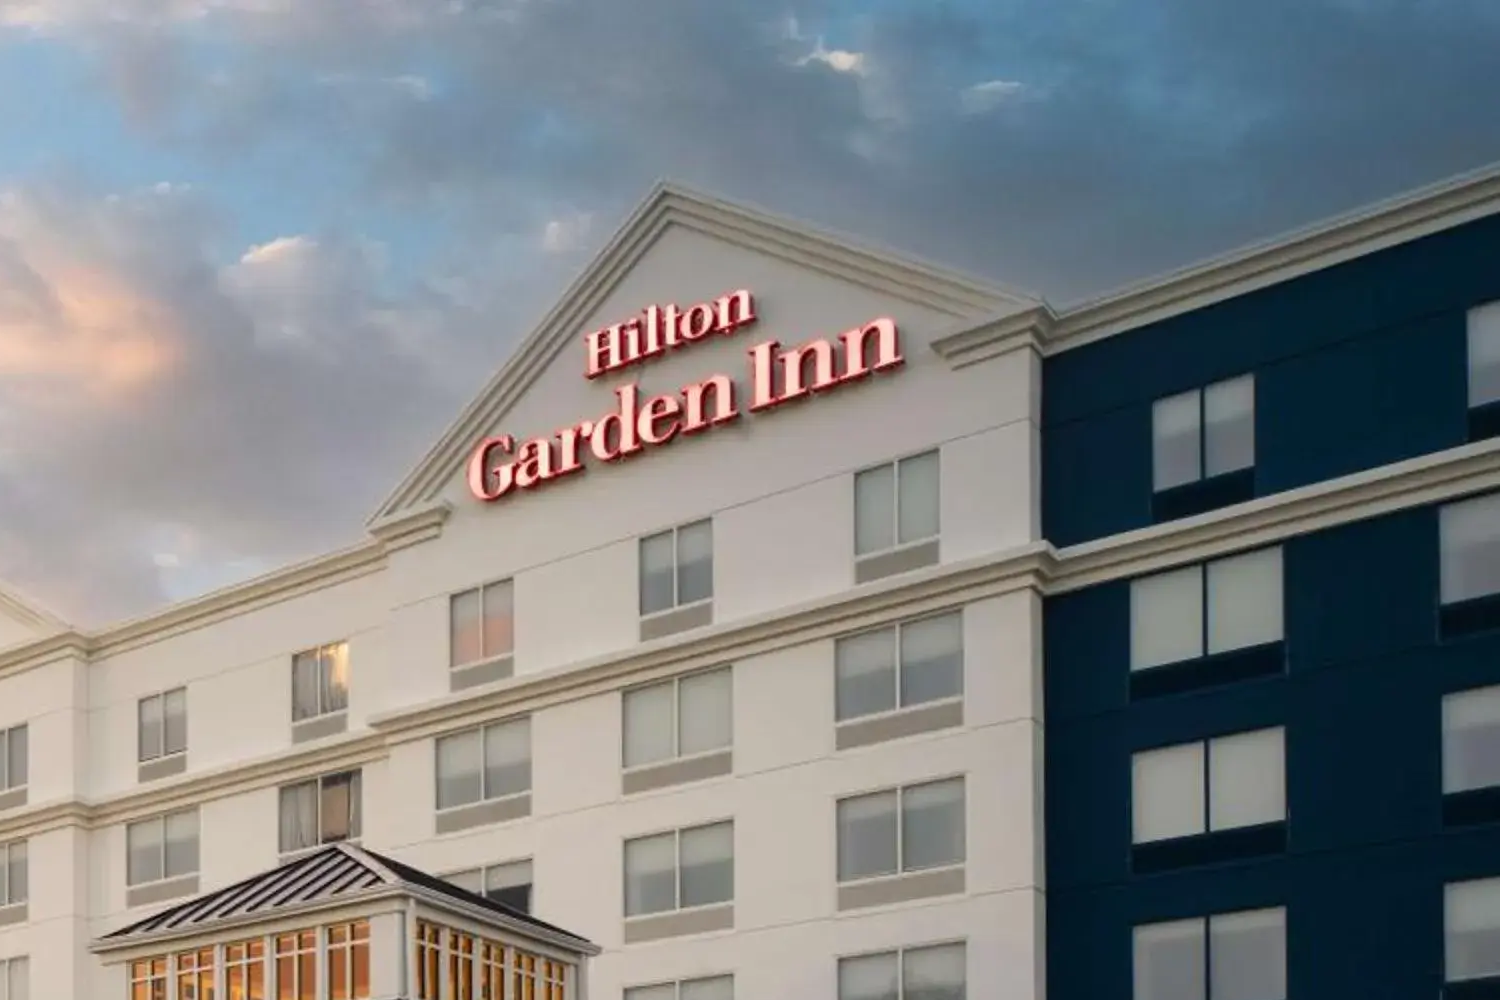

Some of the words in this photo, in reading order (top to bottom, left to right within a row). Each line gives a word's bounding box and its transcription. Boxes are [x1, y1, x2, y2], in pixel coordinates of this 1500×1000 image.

[585, 288, 758, 379] Hilton
[466, 372, 740, 502] Garden
[746, 316, 904, 412] Inn
